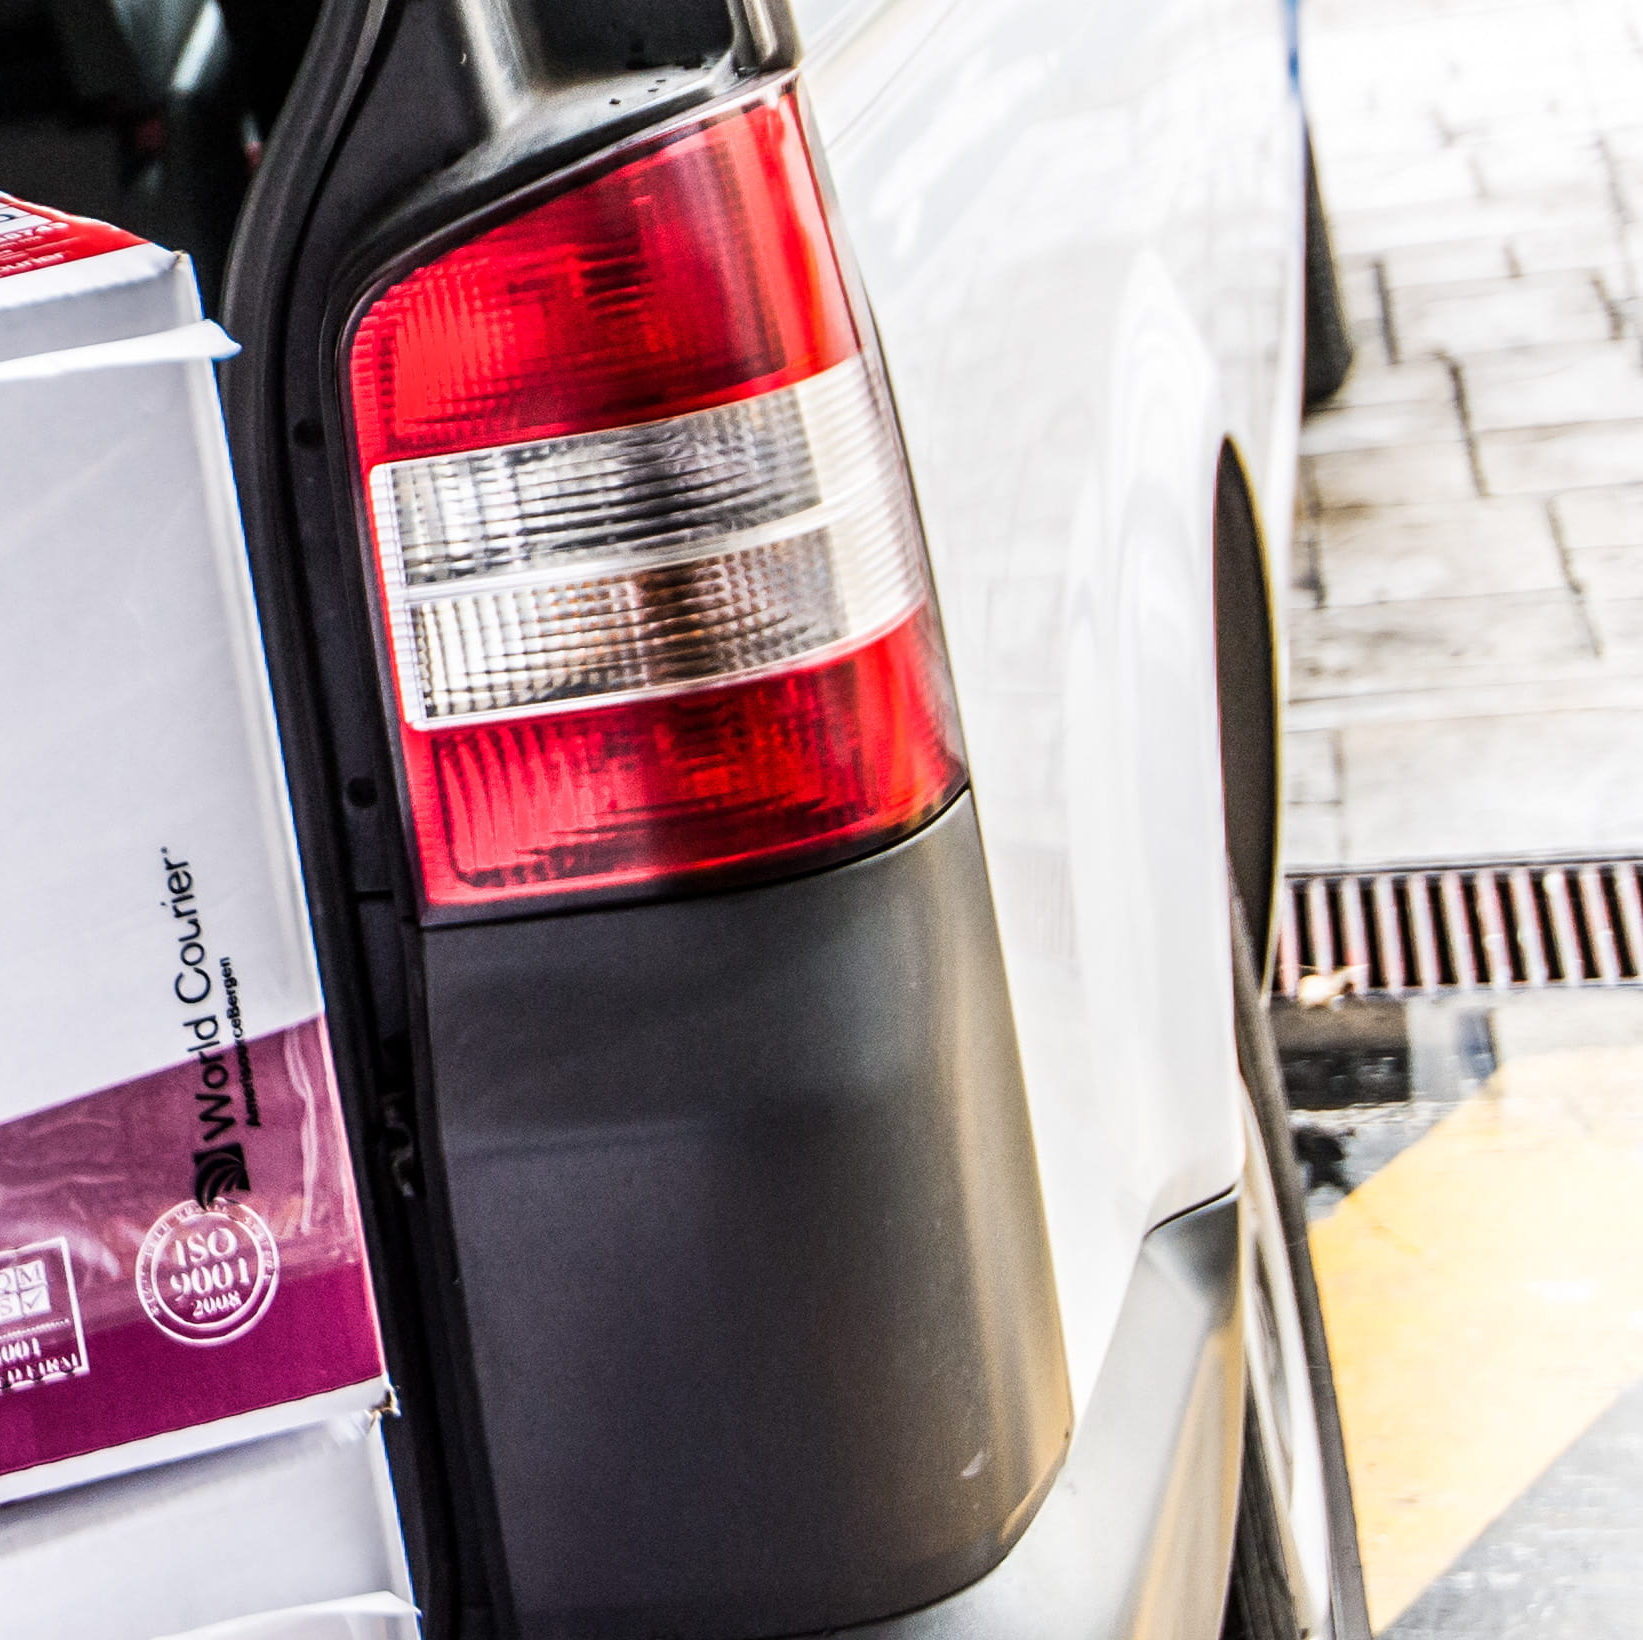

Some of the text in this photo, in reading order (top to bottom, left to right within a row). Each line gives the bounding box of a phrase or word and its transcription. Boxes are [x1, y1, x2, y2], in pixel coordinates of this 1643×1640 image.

[161, 856, 236, 1142] World Courier
[173, 1226, 238, 1269] ISO
[168, 1256, 251, 1306] 9001
[190, 1289, 243, 1320] 2008
